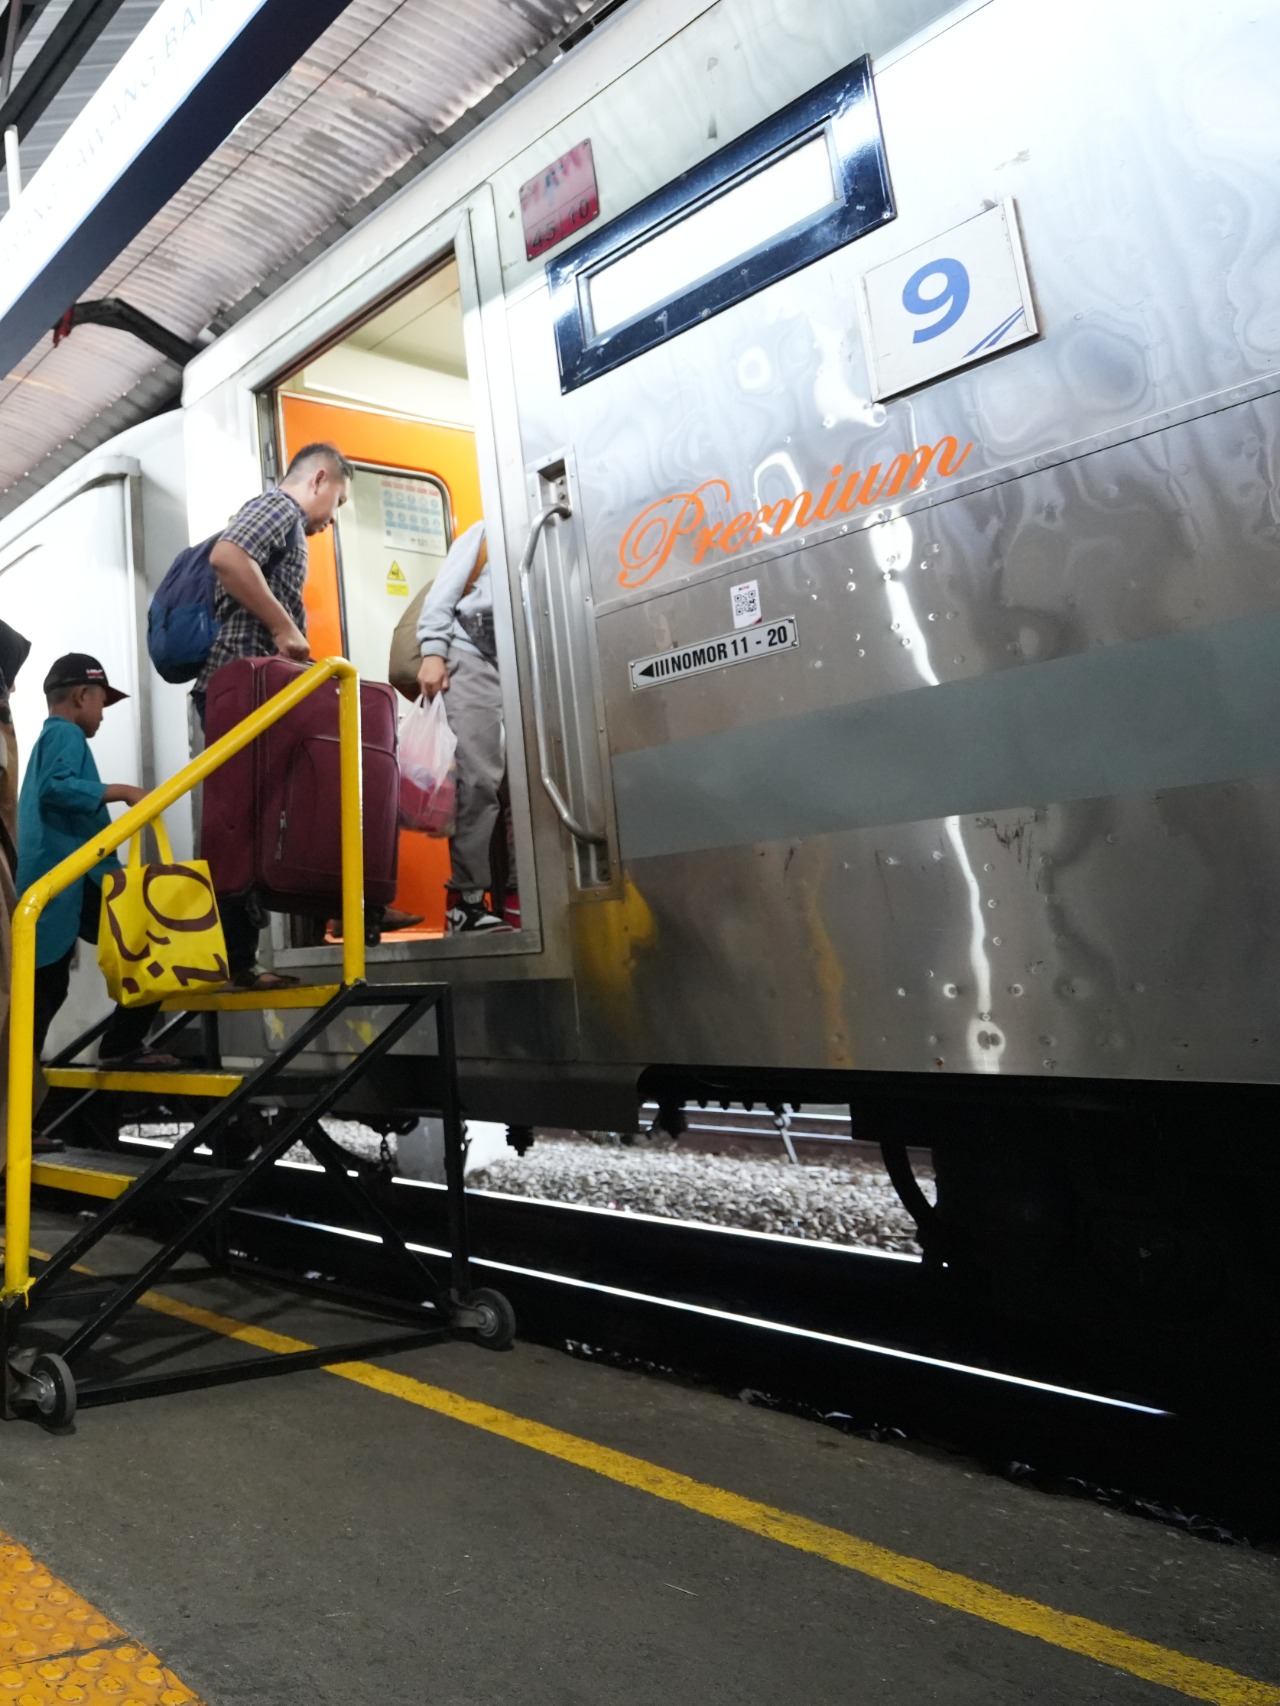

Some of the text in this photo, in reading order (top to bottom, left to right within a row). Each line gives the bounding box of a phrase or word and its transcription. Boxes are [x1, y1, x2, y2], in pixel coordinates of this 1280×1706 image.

[901, 257, 971, 345] 9
[617, 435, 974, 589] Premium
[671, 643, 728, 673] NOMOR
[731, 635, 748, 656] 11
[767, 625, 788, 649] 20
